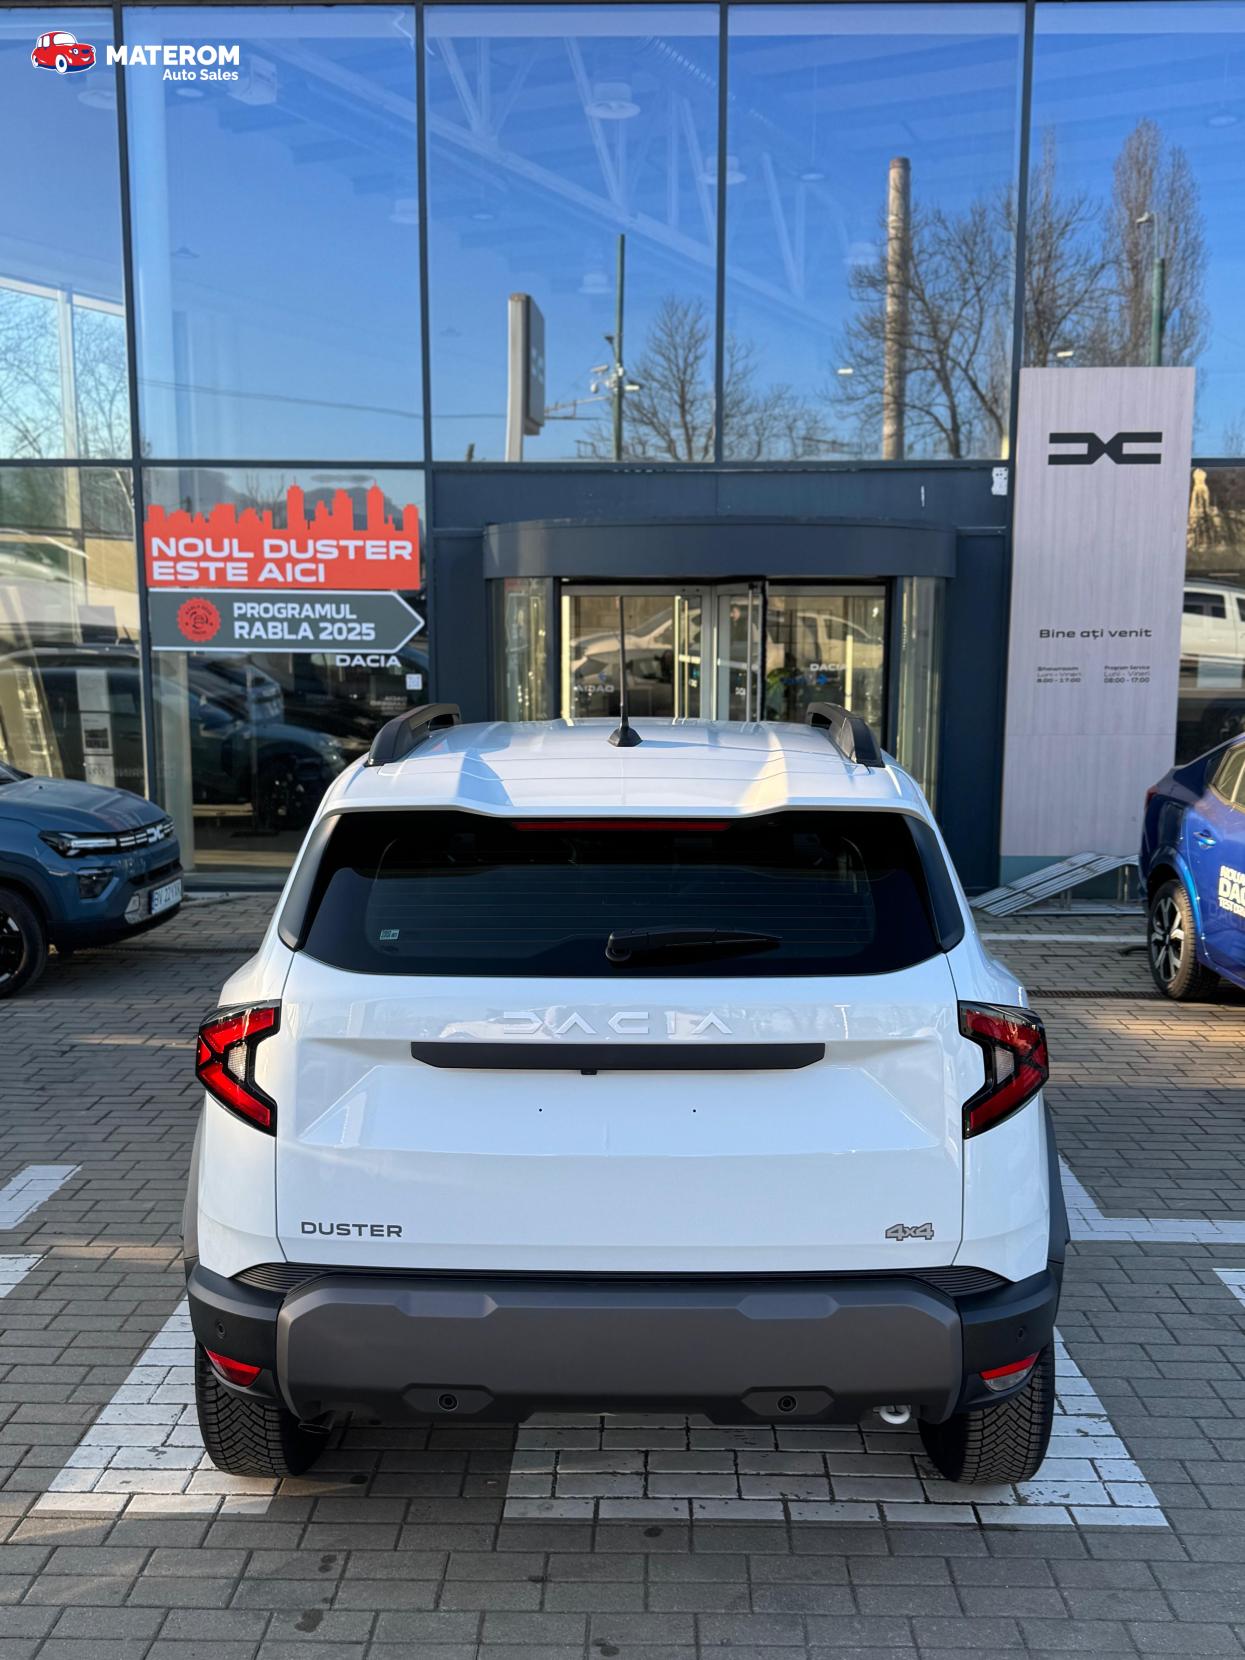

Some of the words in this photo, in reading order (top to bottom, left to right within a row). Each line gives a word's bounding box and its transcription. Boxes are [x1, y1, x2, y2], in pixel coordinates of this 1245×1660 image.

[151, 537, 254, 558] NOUL
[263, 540, 413, 560] DUSTER
[152, 561, 249, 582] ESTE
[257, 563, 325, 583] AICI
[233, 602, 357, 620] PROGRAMUL
[234, 621, 314, 640] RABLA
[319, 623, 376, 641] 2025
[1039, 629, 1076, 639] Bine
[1108, 628, 1153, 638] venit
[335, 655, 402, 668] DACIA
[503, 1011, 733, 1035] DACIA
[301, 1221, 403, 1238] DUSTER
[885, 1222, 935, 1241] 4x4
